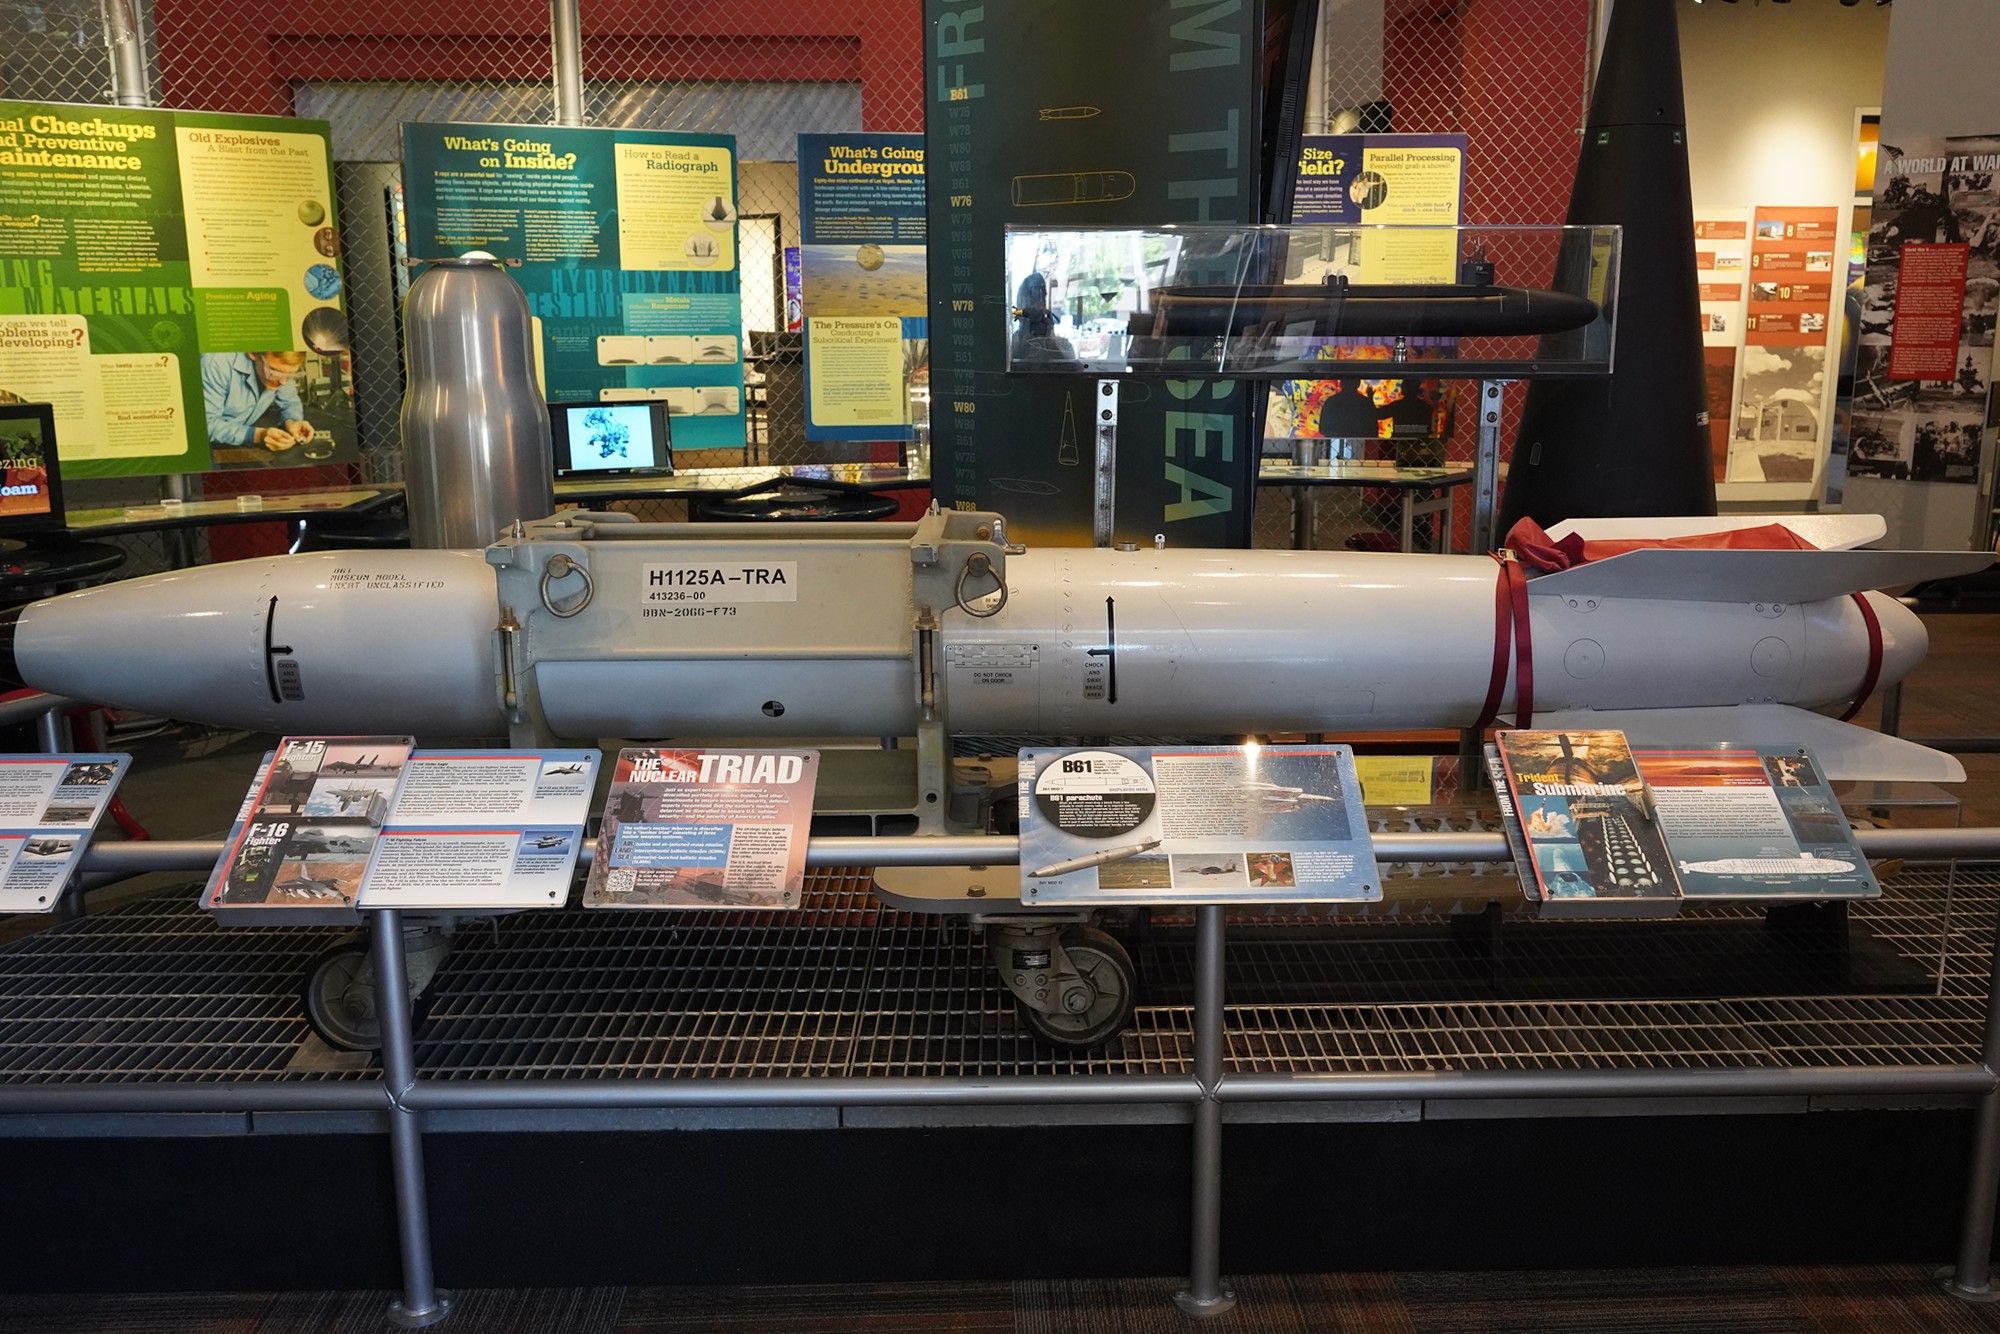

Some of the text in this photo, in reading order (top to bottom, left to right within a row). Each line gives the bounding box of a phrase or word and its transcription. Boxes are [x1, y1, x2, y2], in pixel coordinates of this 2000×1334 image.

[950, 88, 968, 101] B61
[30, 115, 156, 142] Checkups
[22, 133, 127, 152] Preventive
[189, 132, 281, 147] Old Explosives
[444, 136, 551, 155] What's Going
[207, 144, 309, 157] A Blast from the Past
[624, 149, 648, 158] How
[652, 151, 662, 159] to
[664, 150, 690, 160] Read
[830, 146, 924, 162] What's Going
[1303, 148, 1333, 160] Size
[0, 147, 142, 171] aintenance
[480, 152, 577, 170] on Inside?
[1370, 154, 1456, 162] Parallel Processing
[646, 160, 718, 174] Radiograph
[824, 159, 925, 178] Undergrou
[1884, 160, 1893, 175] A
[1898, 158, 1946, 174] WORLD
[1950, 156, 1968, 172] AT
[950, 195, 972, 207] W76
[1696, 224, 1702, 236] 4
[1786, 224, 1794, 238] 8
[1752, 254, 1760, 267] 9
[246, 291, 277, 301] Aging
[1779, 286, 1790, 298] 10
[952, 300, 974, 312] W78
[6, 320, 26, 328] can
[50, 319, 67, 328] tell
[814, 320, 898, 330] The Pressure's On
[1748, 318, 1756, 328] 11
[813, 336, 853, 344] Subcritical
[954, 402, 975, 414] W80
[955, 500, 976, 512] W88
[329, 581, 444, 590] INERT UNCLASSIFIED
[649, 591, 706, 601] 413236-00
[642, 607, 737, 618] BBN-2066-F73
[285, 740, 326, 754] F-15
[279, 754, 316, 762] Fighter
[629, 754, 803, 784] NUCLEAR TRIAD
[633, 758, 662, 771] THE
[1062, 760, 1092, 773] B61
[1516, 772, 1560, 784] Trident
[1532, 782, 1626, 796] Submarine
[1066, 794, 1102, 802] parachute
[248, 822, 290, 838] F-16
[244, 838, 282, 847] Fighter
